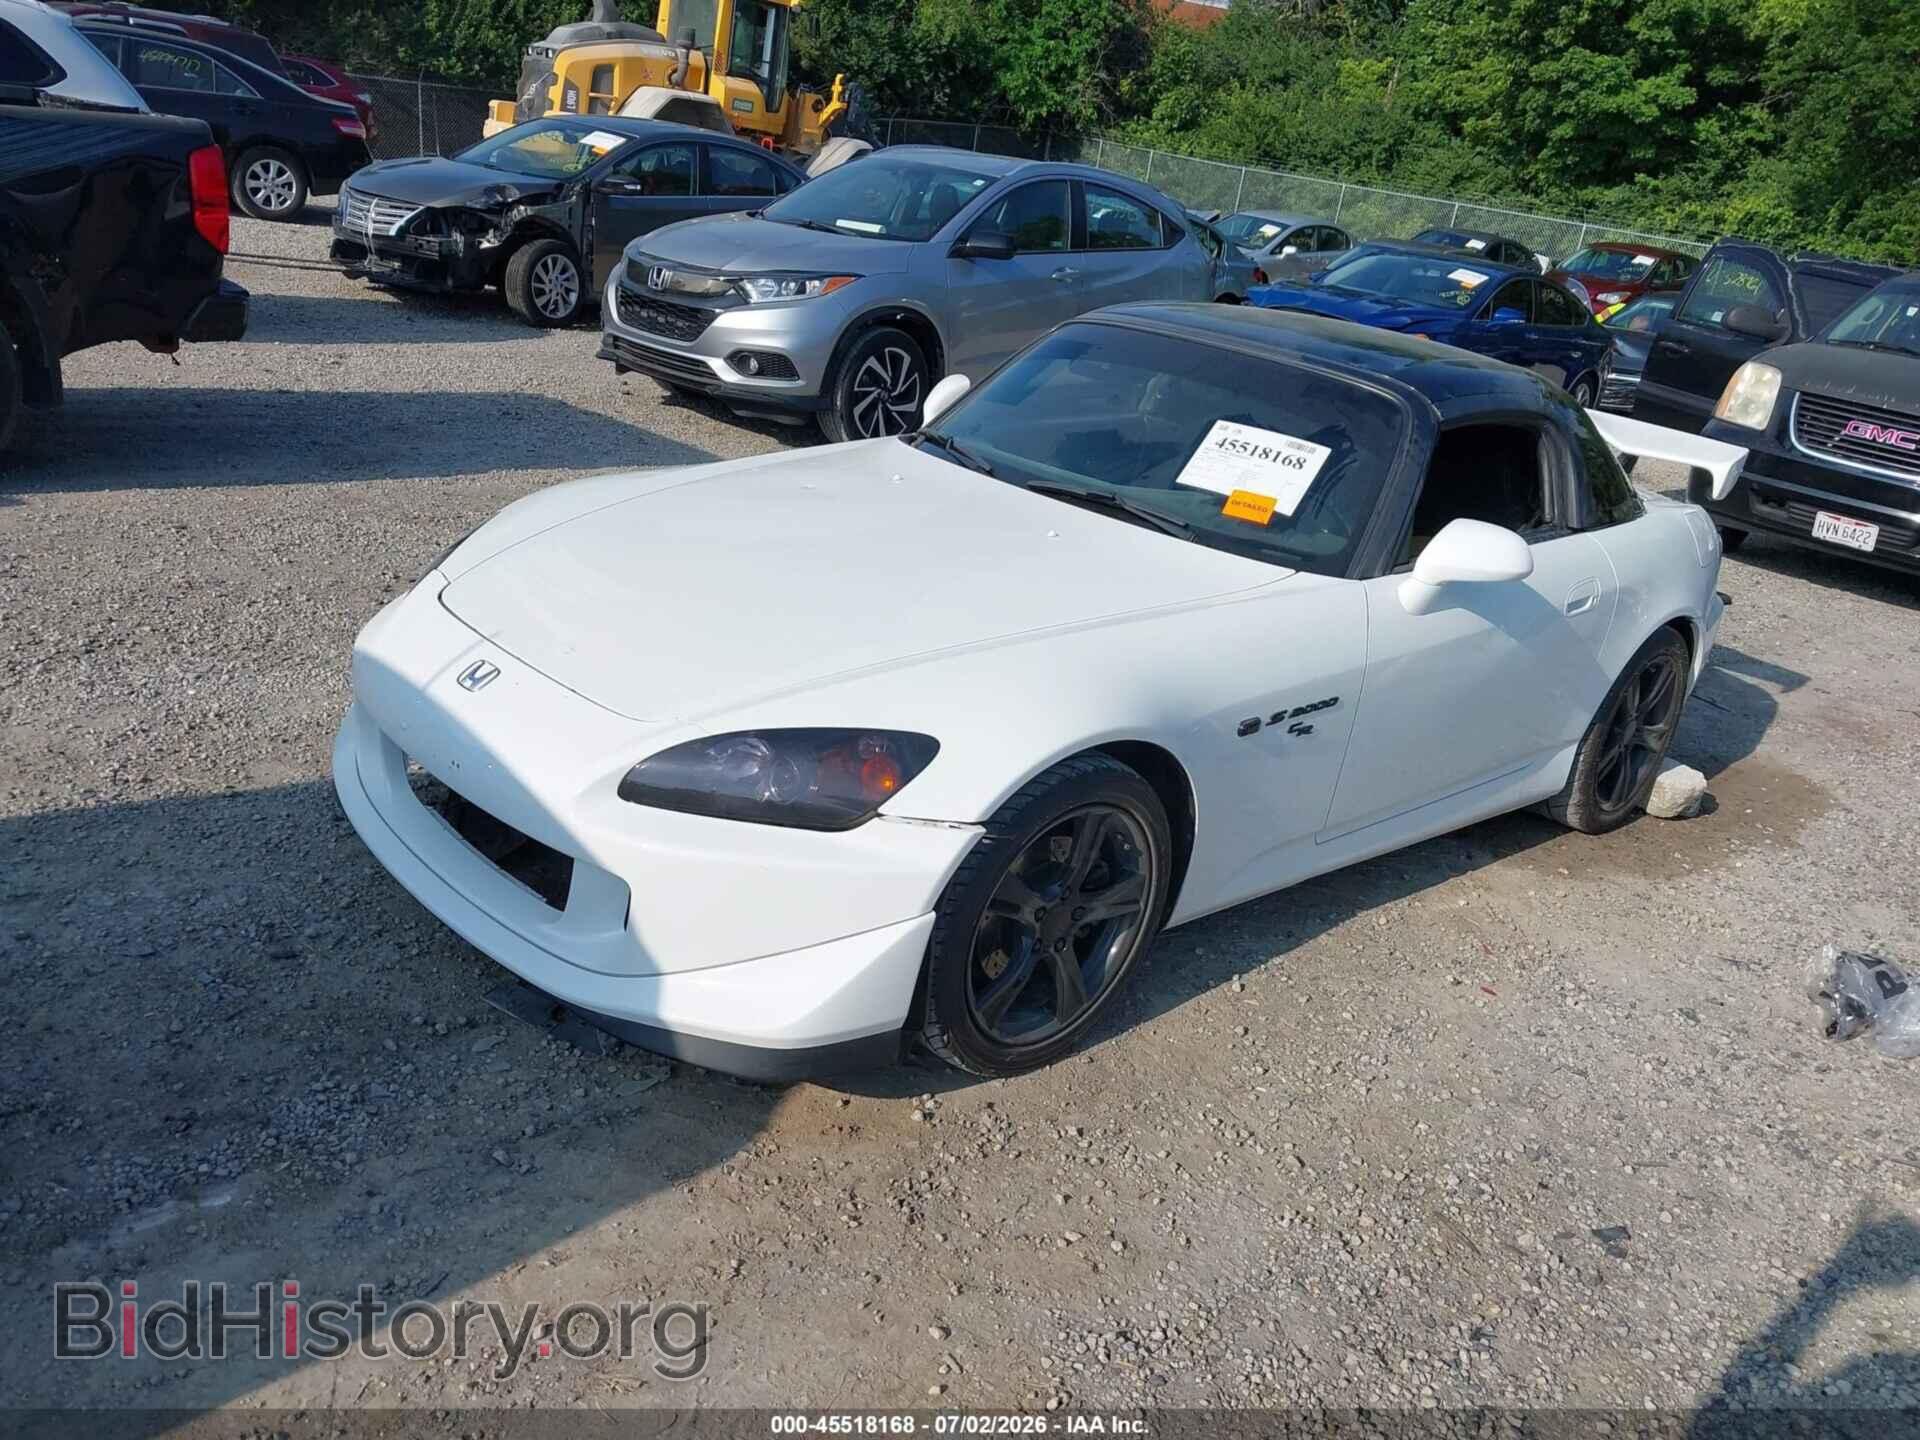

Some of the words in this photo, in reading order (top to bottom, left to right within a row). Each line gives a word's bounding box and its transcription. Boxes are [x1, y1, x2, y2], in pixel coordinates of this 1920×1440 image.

[1844, 420, 1920, 450] GMC
[1214, 436, 1308, 471] 45518168
[1816, 519, 1840, 537] HVN
[1841, 526, 1873, 545] 6422
